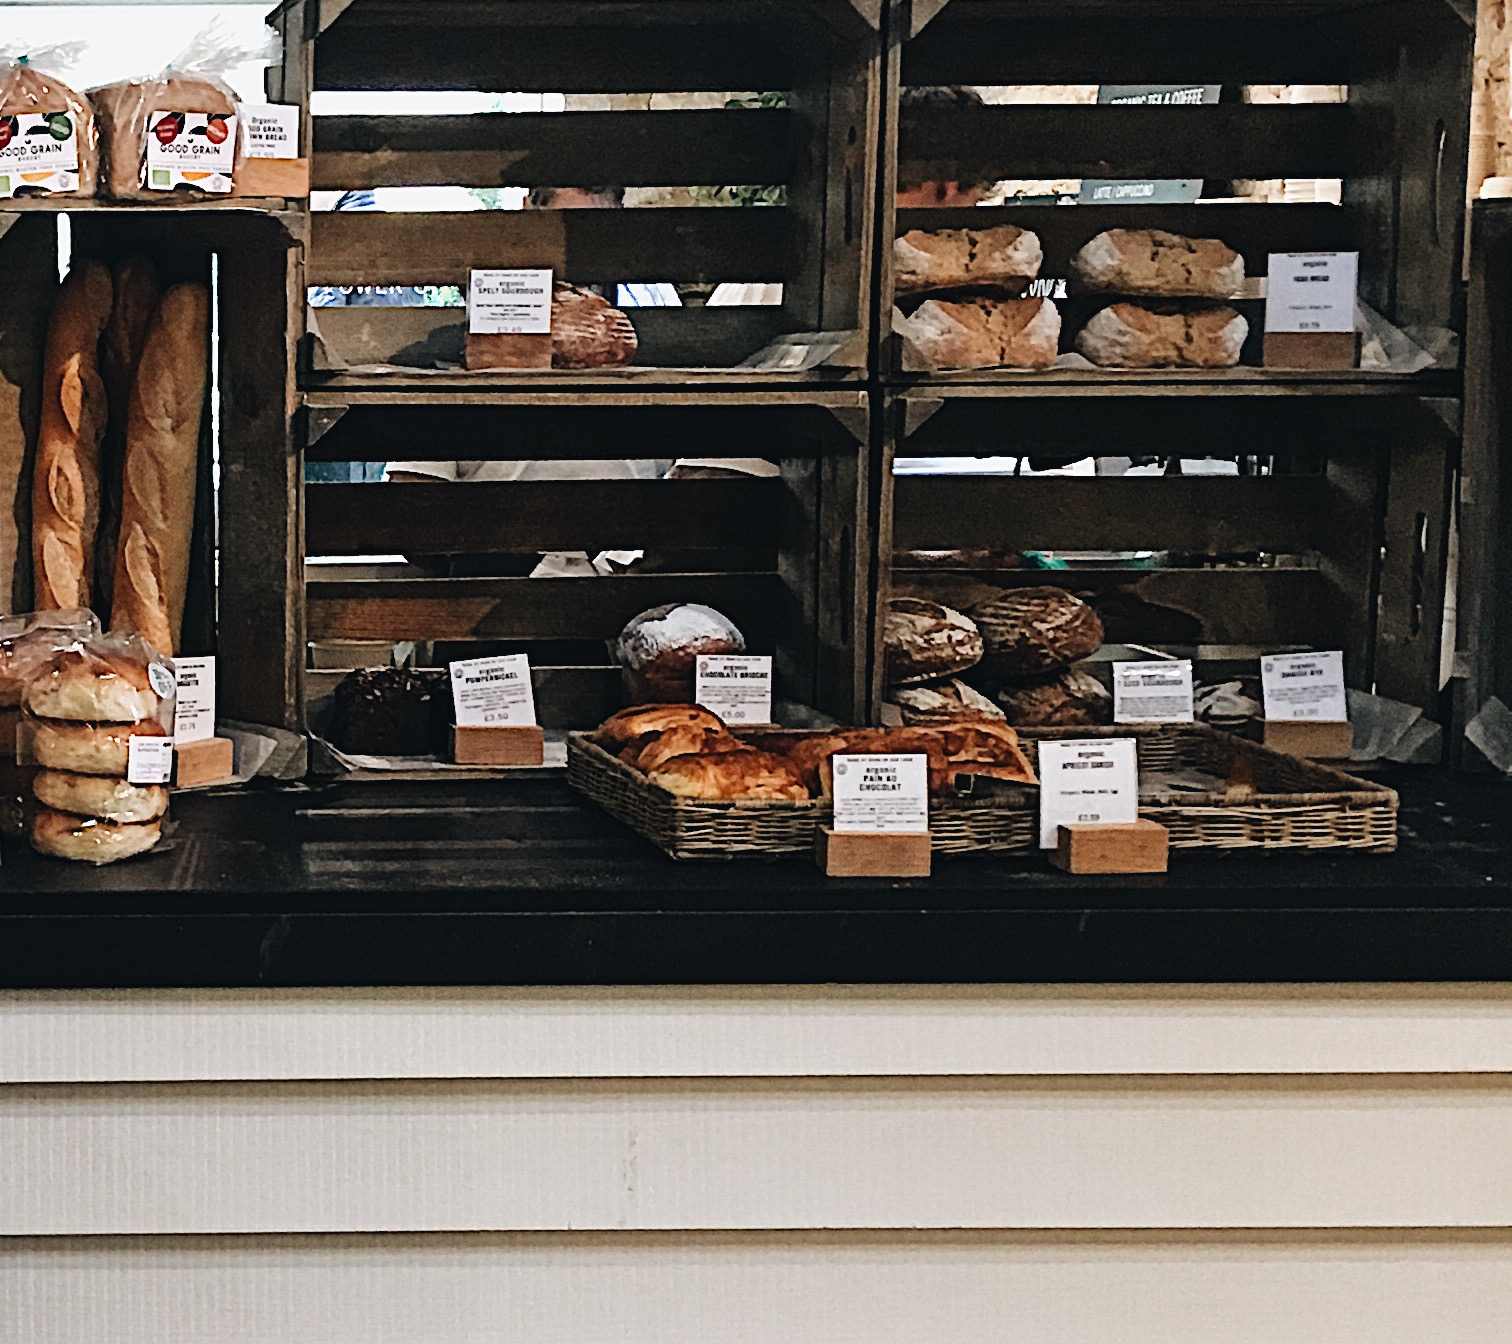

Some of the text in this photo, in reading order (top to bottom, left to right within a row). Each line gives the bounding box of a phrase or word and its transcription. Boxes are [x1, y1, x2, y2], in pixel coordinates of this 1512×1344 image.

[30, 144, 62, 155] GRAIN
[160, 144, 221, 154] GOOD GRAIN
